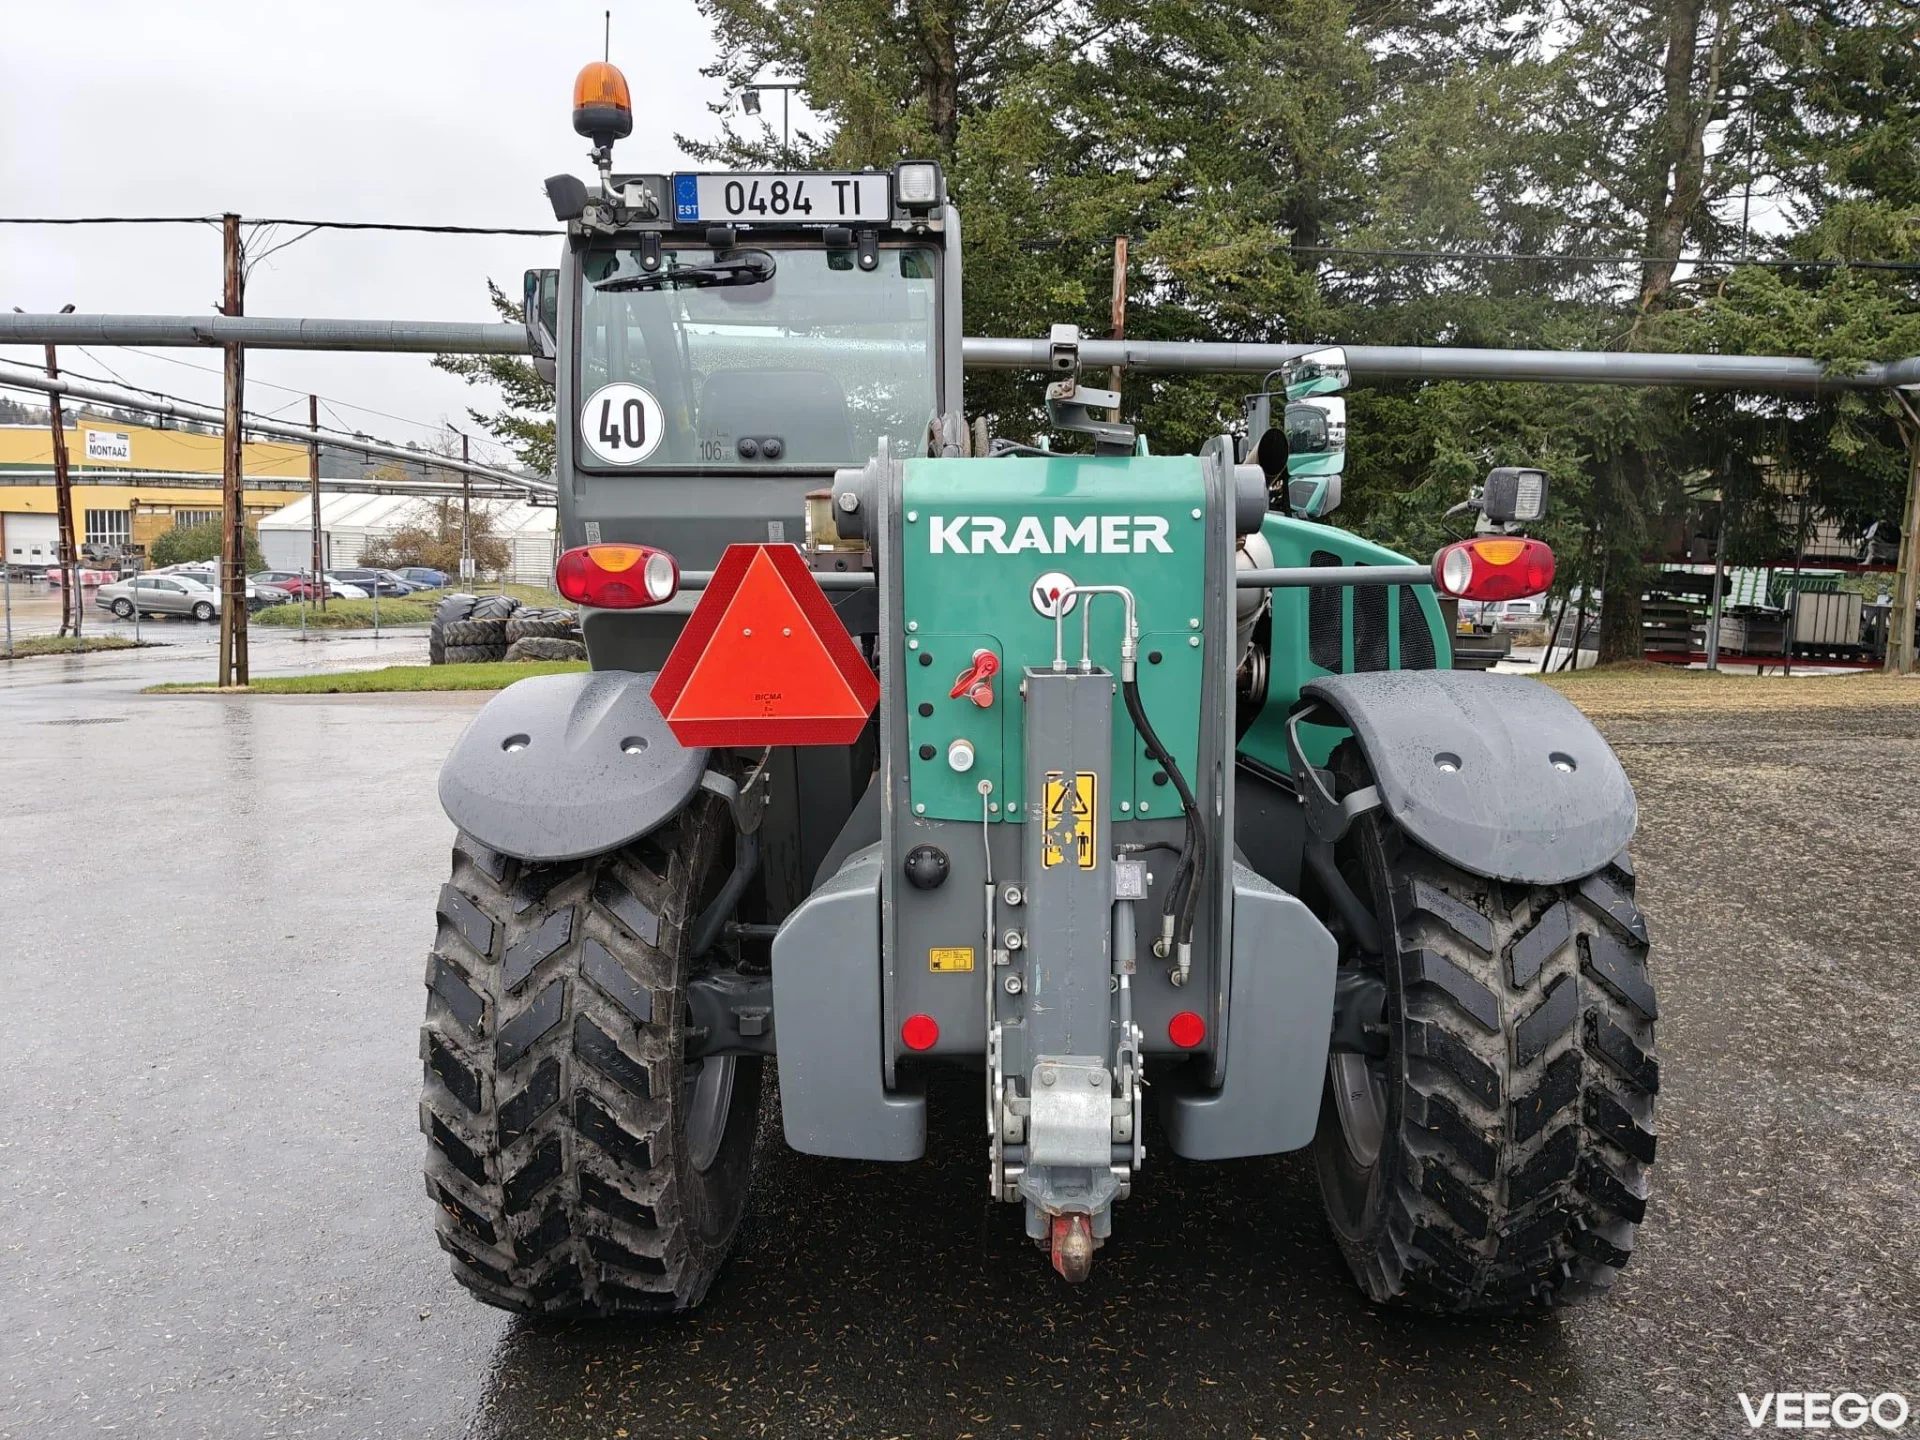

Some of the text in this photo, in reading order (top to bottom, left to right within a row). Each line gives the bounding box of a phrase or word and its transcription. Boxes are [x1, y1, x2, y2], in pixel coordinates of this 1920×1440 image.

[678, 204, 698, 215] EST
[724, 180, 861, 215] 0484 TI
[599, 398, 646, 449] 40
[89, 443, 127, 458] MONTAAŽ
[700, 440, 722, 461] 106
[929, 515, 1174, 554] KRAMER
